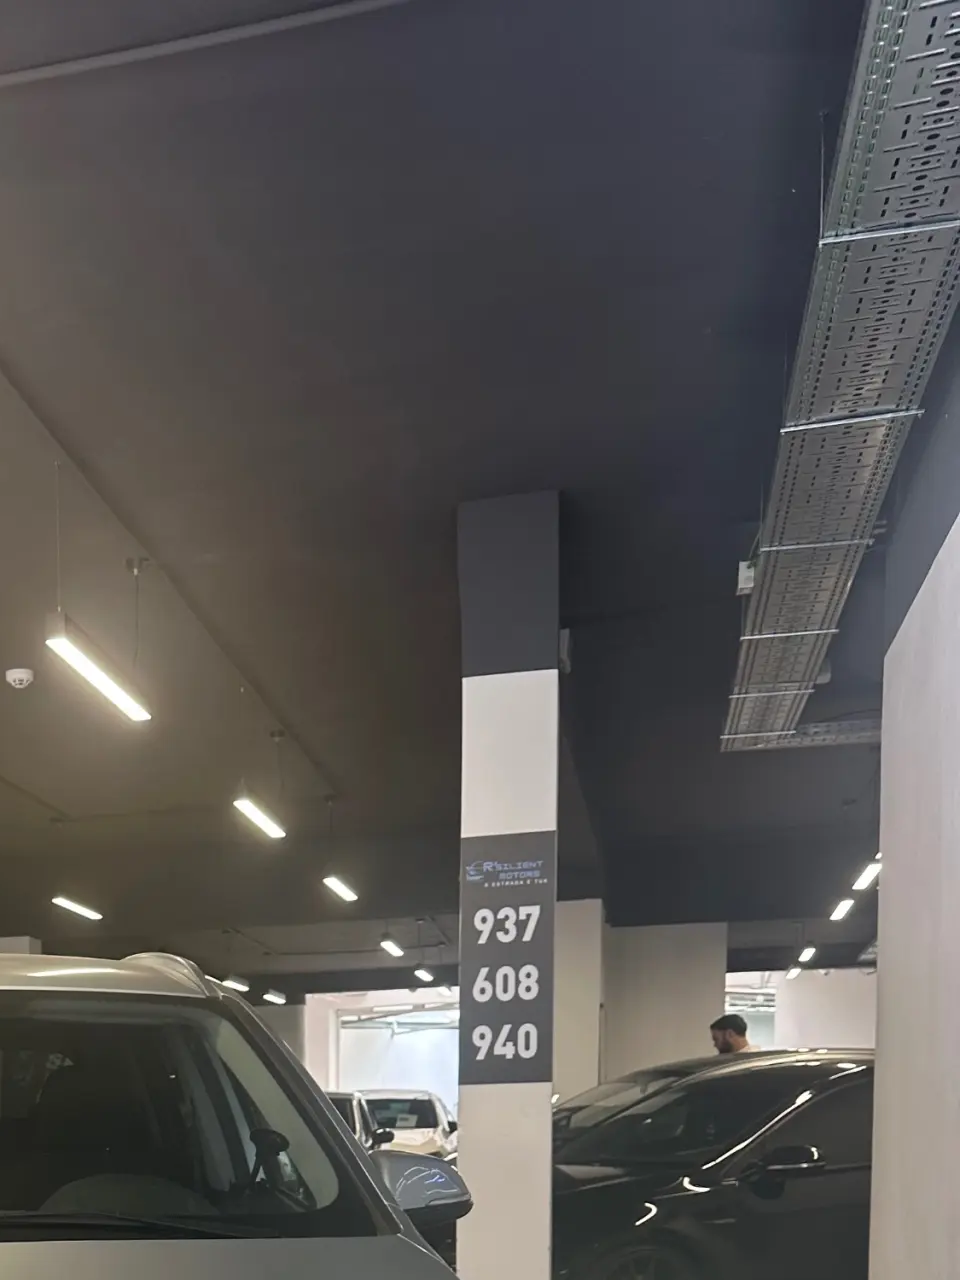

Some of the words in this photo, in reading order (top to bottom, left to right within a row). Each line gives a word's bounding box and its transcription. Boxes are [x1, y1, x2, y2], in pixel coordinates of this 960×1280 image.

[473, 905, 541, 945] 937
[472, 964, 539, 1003] 608
[472, 1022, 538, 1061] 940
